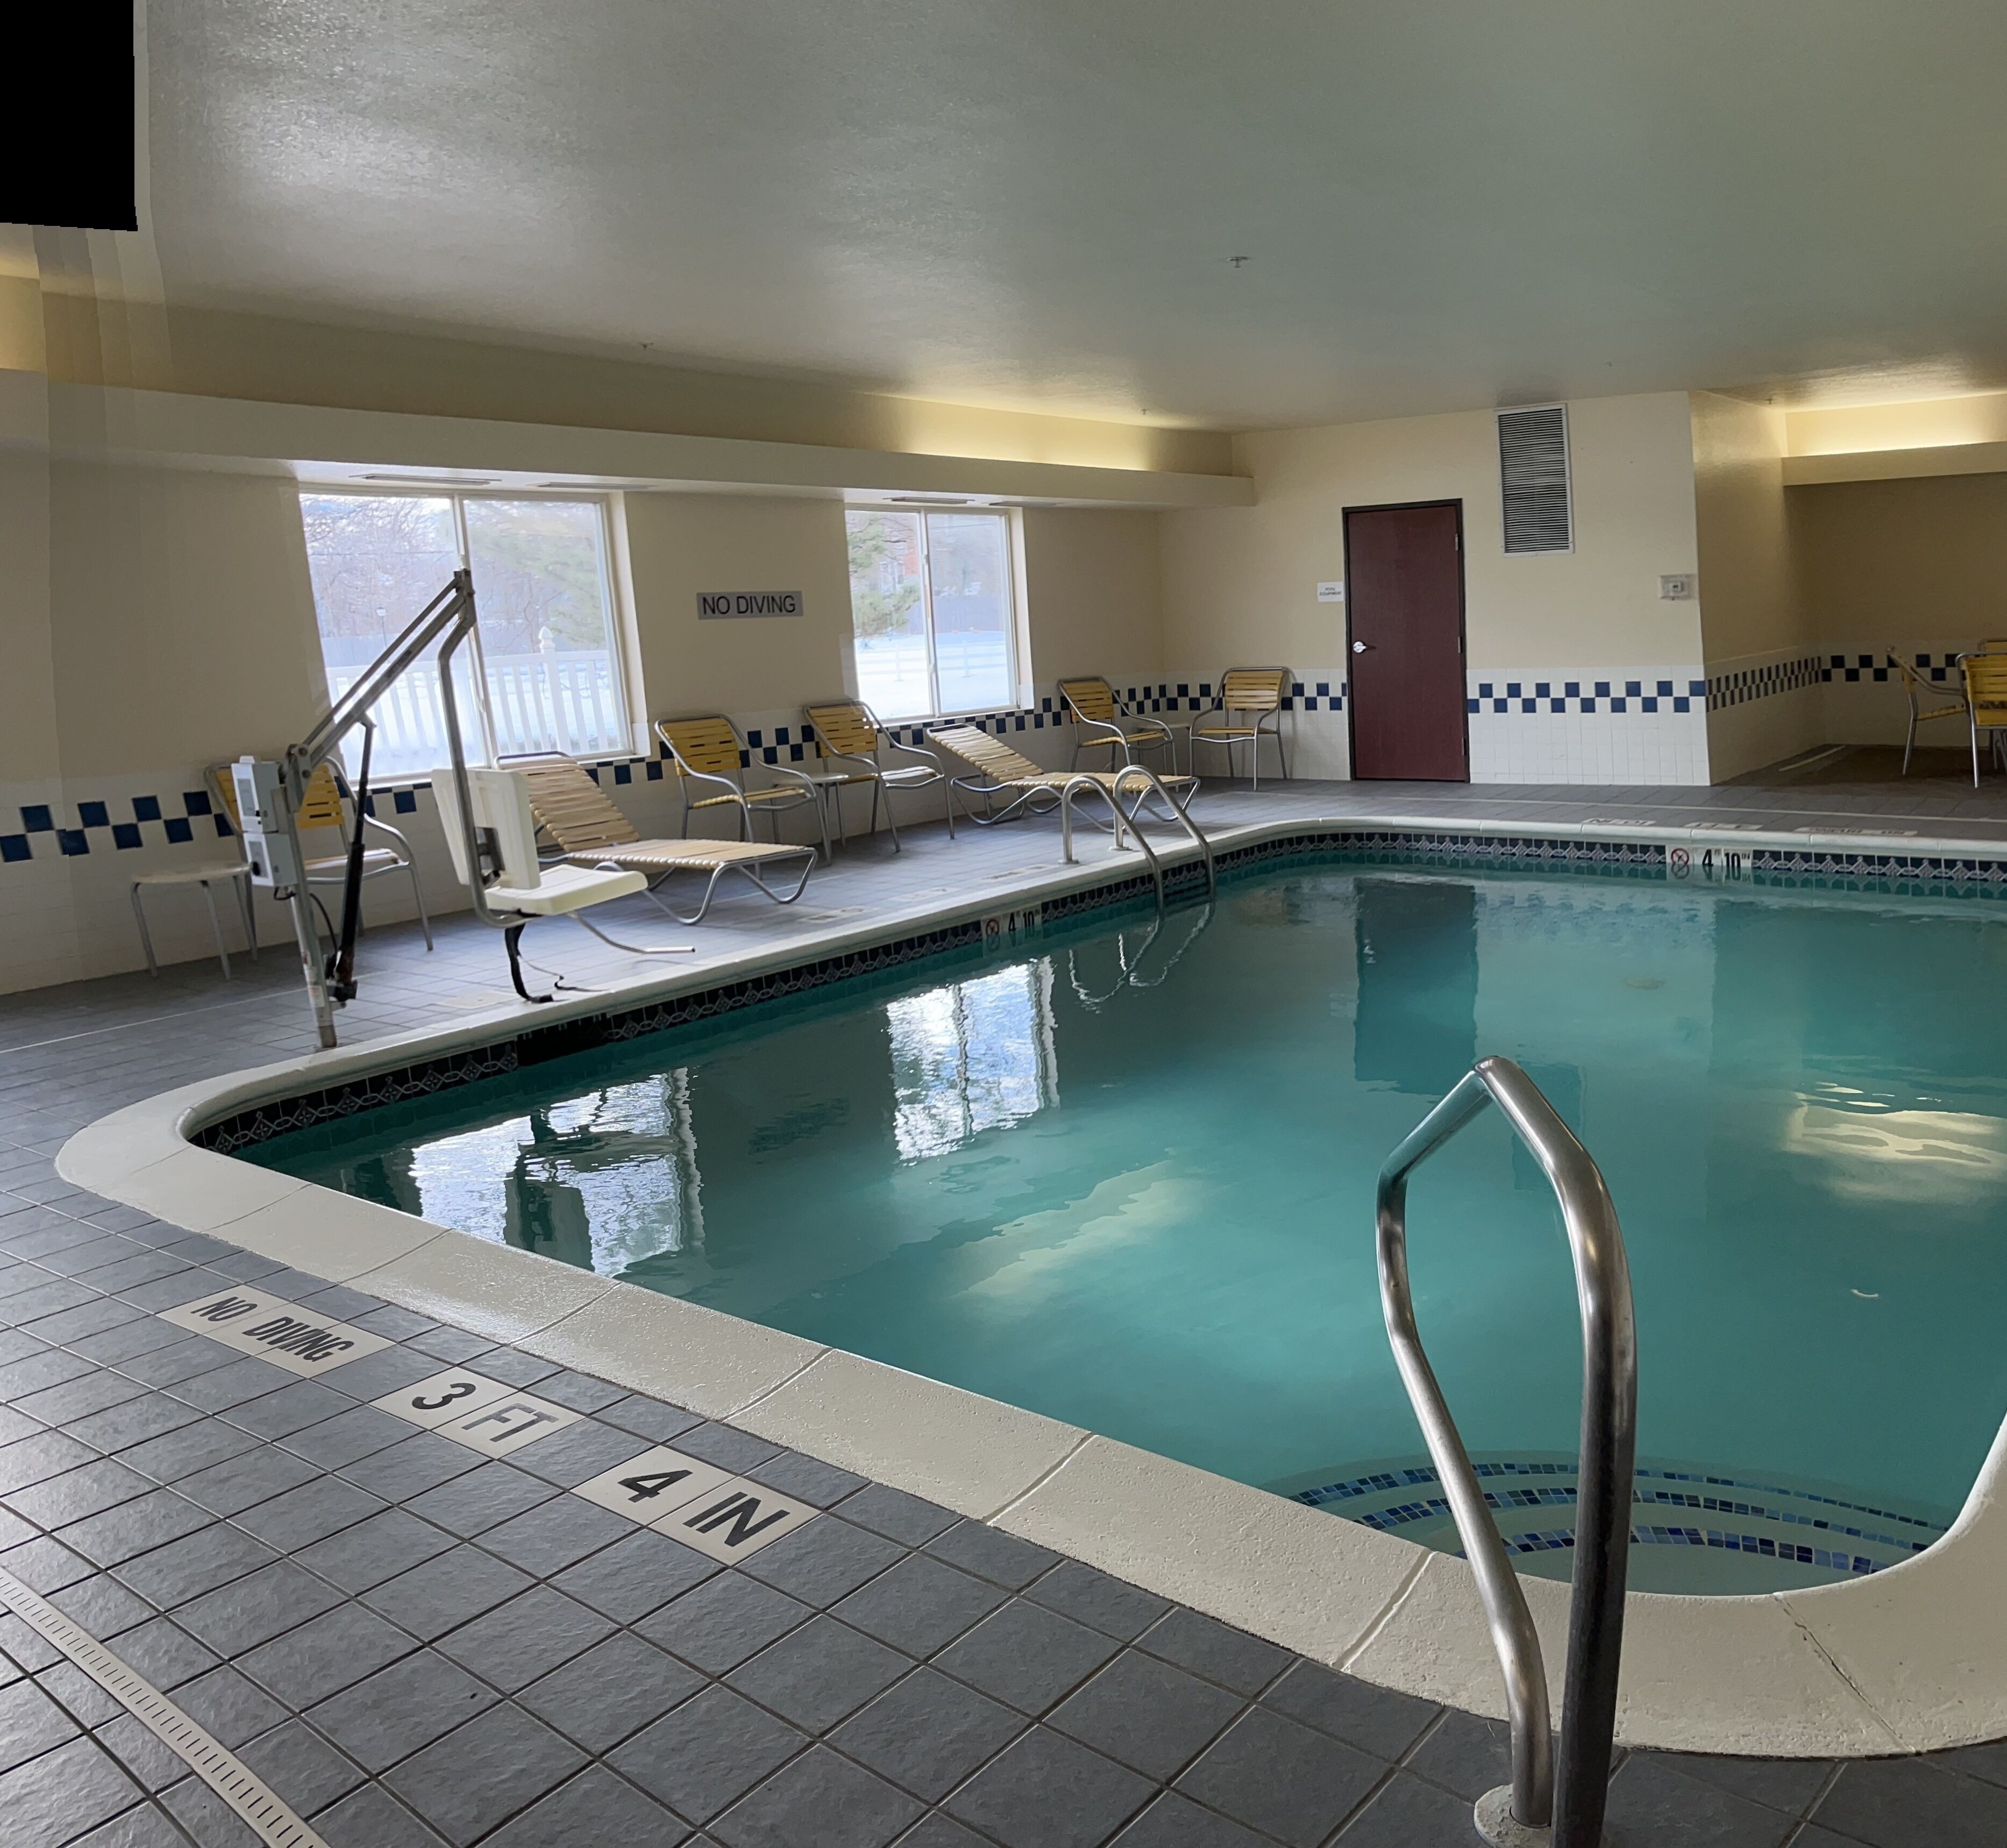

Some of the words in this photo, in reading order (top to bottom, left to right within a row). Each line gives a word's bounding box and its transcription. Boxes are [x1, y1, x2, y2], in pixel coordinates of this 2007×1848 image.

[702, 596, 730, 615] NO
[737, 595, 795, 614] DIVING
[1702, 849, 1713, 866] 4
[1724, 852, 1741, 867] 10
[1008, 913, 1016, 931] 4
[1023, 912, 1034, 926] 10
[191, 1295, 258, 1323] NO
[243, 1316, 355, 1363] DIVING
[411, 1382, 476, 1411] 3
[461, 1403, 559, 1443] FT
[618, 1469, 692, 1503] 4
[682, 1491, 791, 1547] IN
